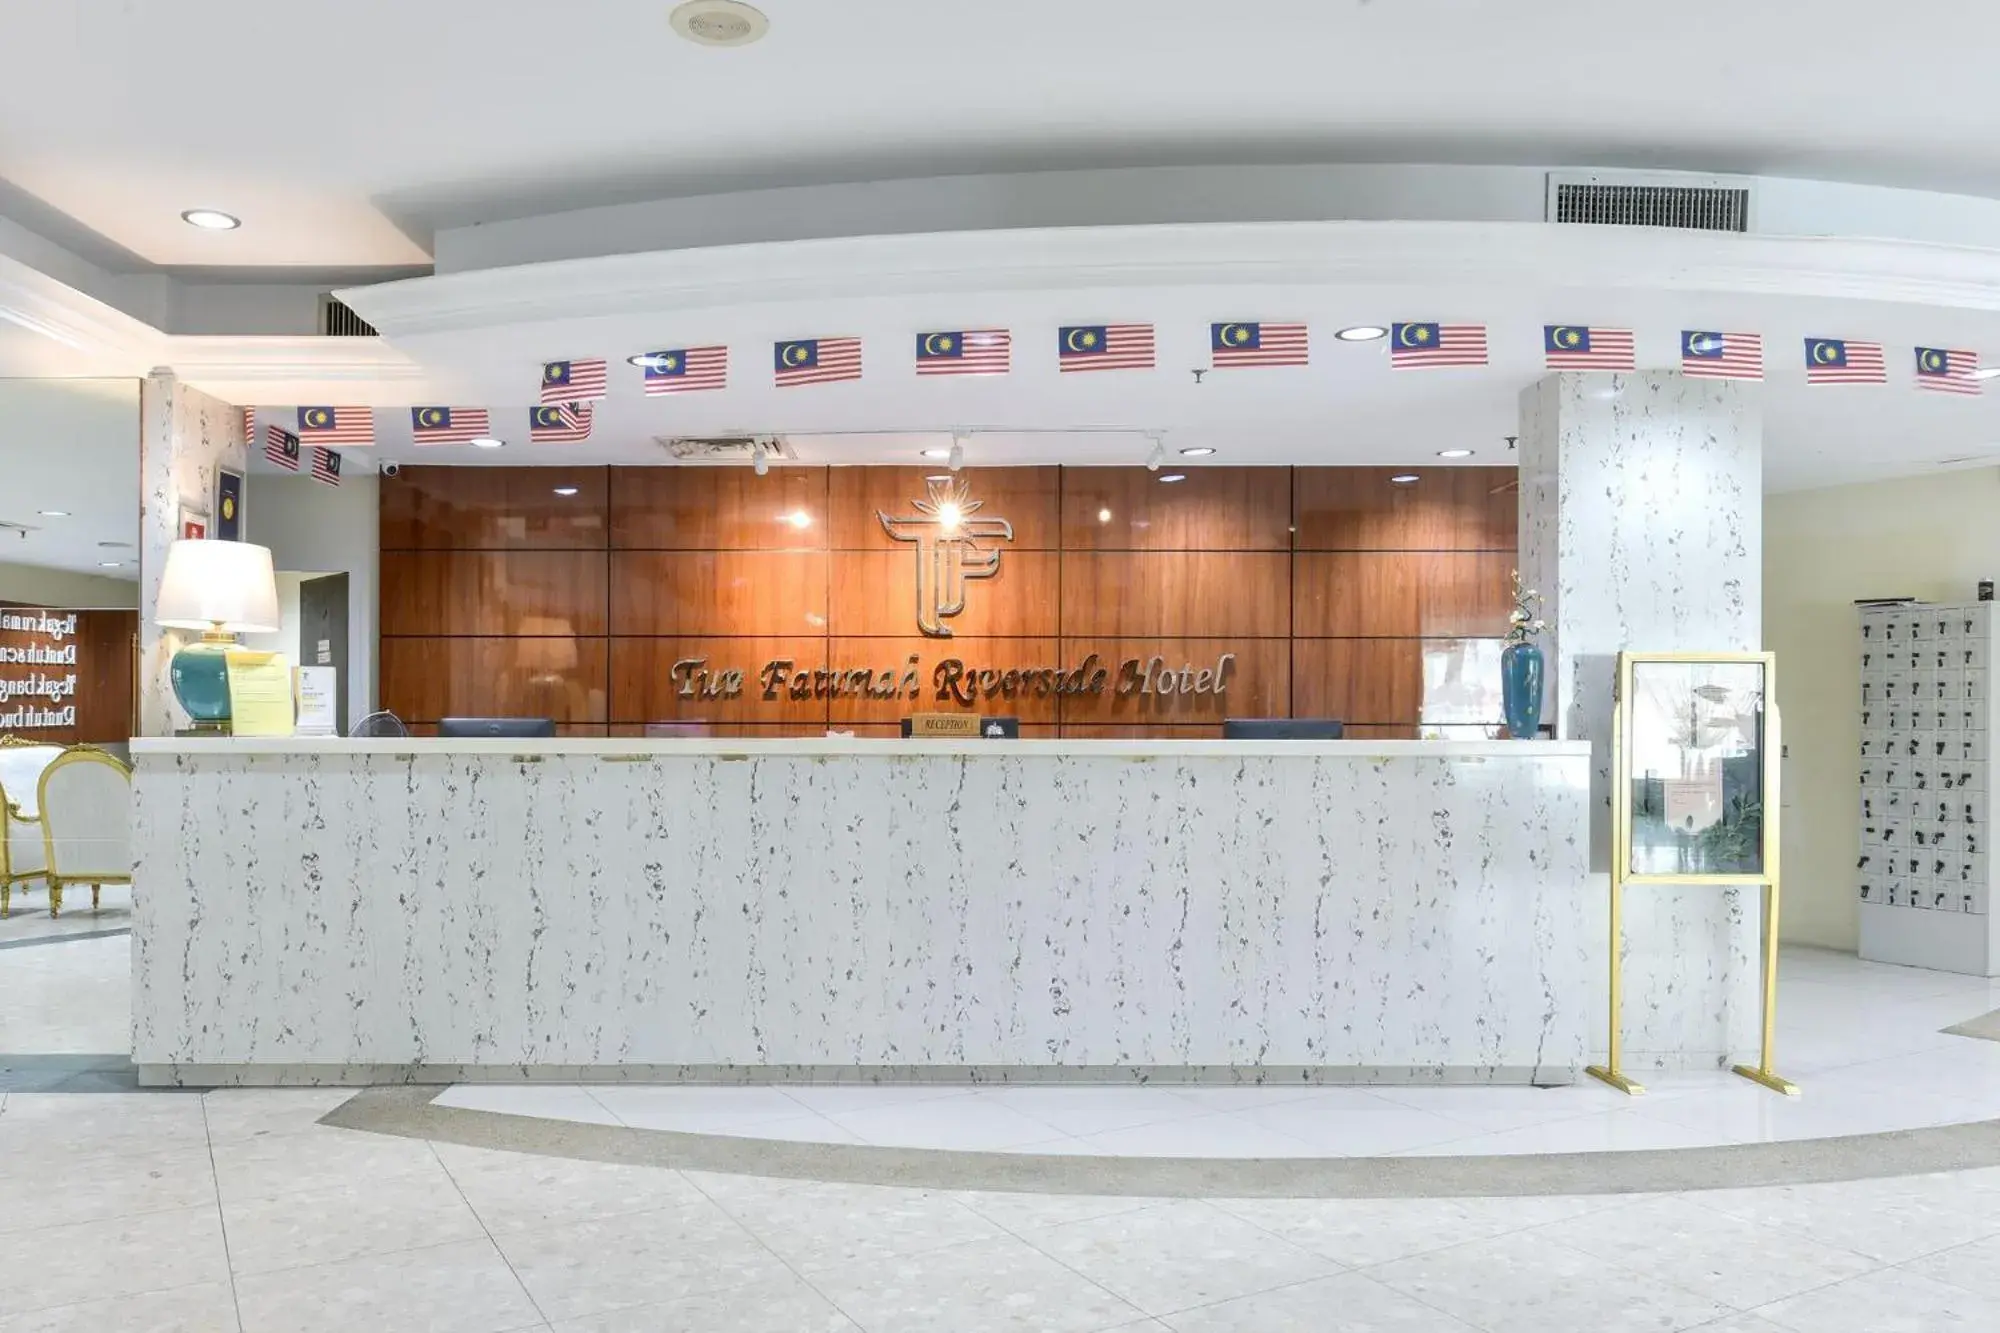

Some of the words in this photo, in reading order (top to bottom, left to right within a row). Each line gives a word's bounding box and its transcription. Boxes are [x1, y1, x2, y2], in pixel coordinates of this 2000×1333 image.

[670, 656, 745, 699] Tun
[760, 653, 921, 701] Fatimah
[933, 653, 1108, 708] Riverside
[1120, 653, 1236, 697] Hotel
[924, 719, 970, 730] RECEPTION
